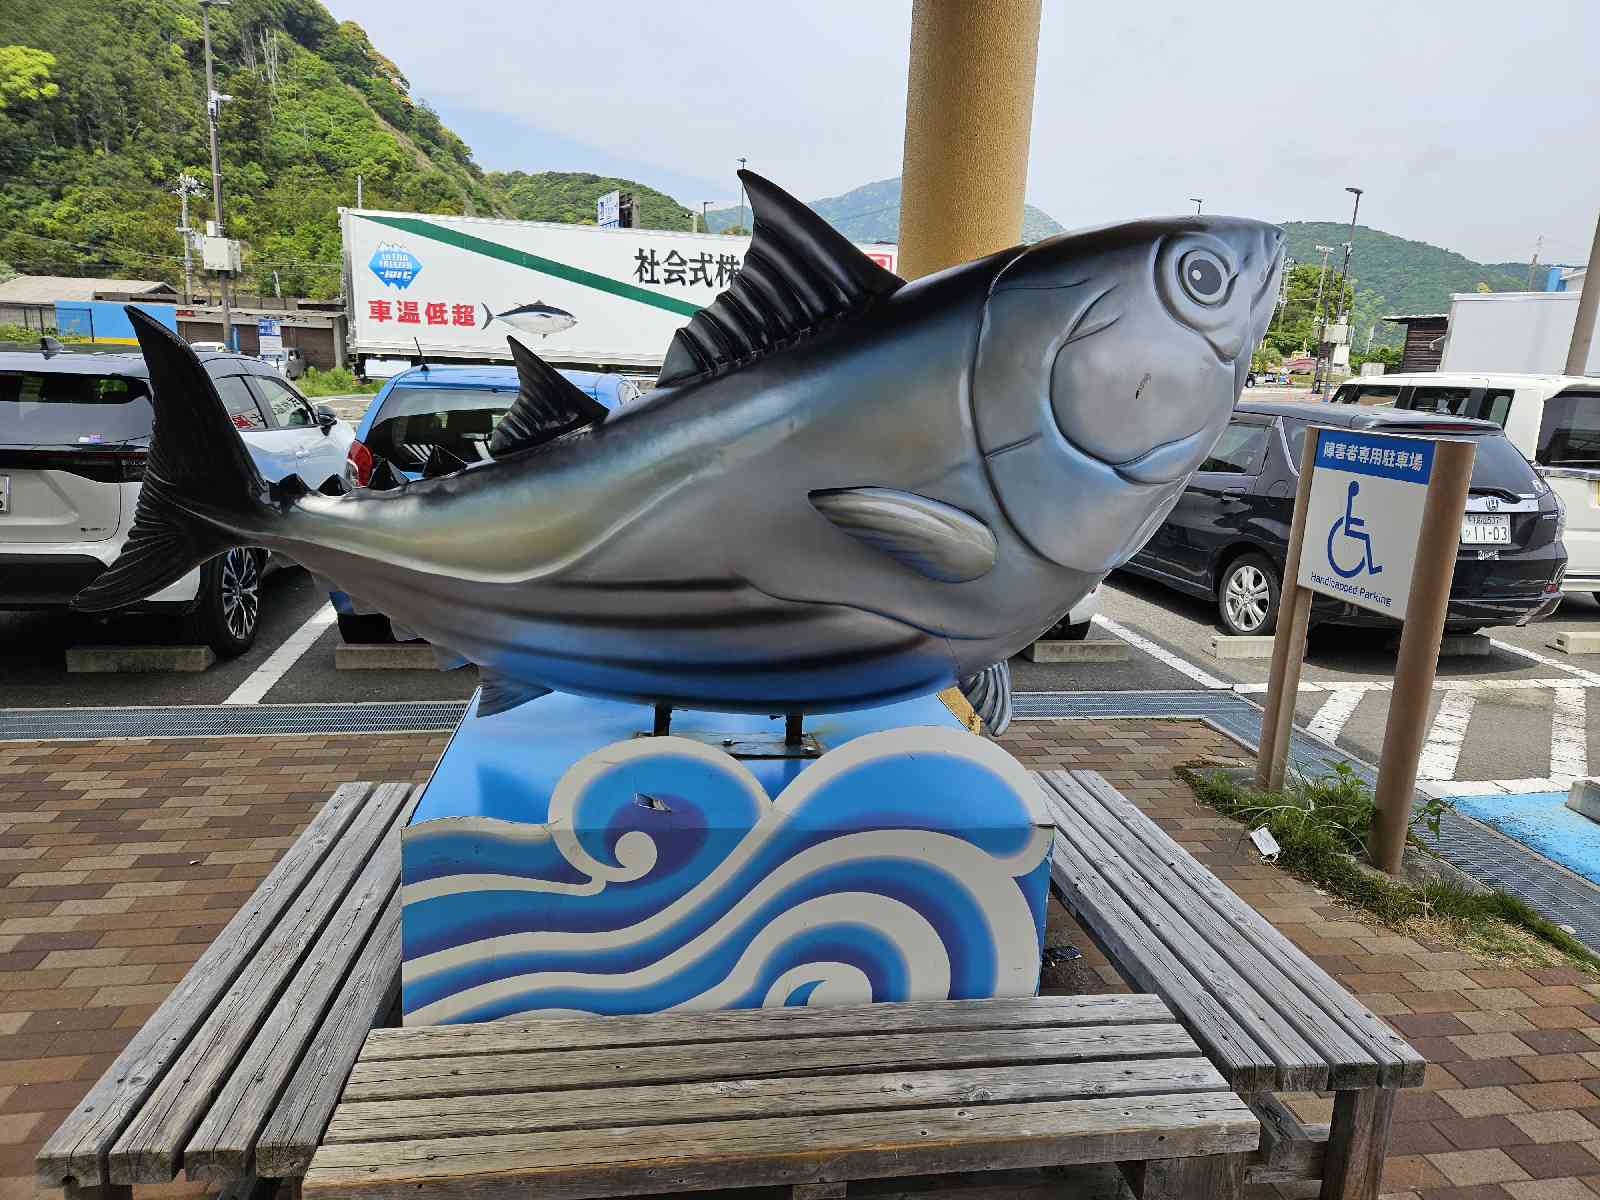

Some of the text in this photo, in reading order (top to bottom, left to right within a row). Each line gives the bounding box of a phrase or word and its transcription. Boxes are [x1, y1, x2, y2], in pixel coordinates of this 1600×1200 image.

[633, 248, 742, 288] 社会式株
[1323, 441, 1424, 472] 障害者専用駐車場
[1474, 526, 1508, 541] 11-03
[1311, 571, 1392, 607] Handicapped Parking
